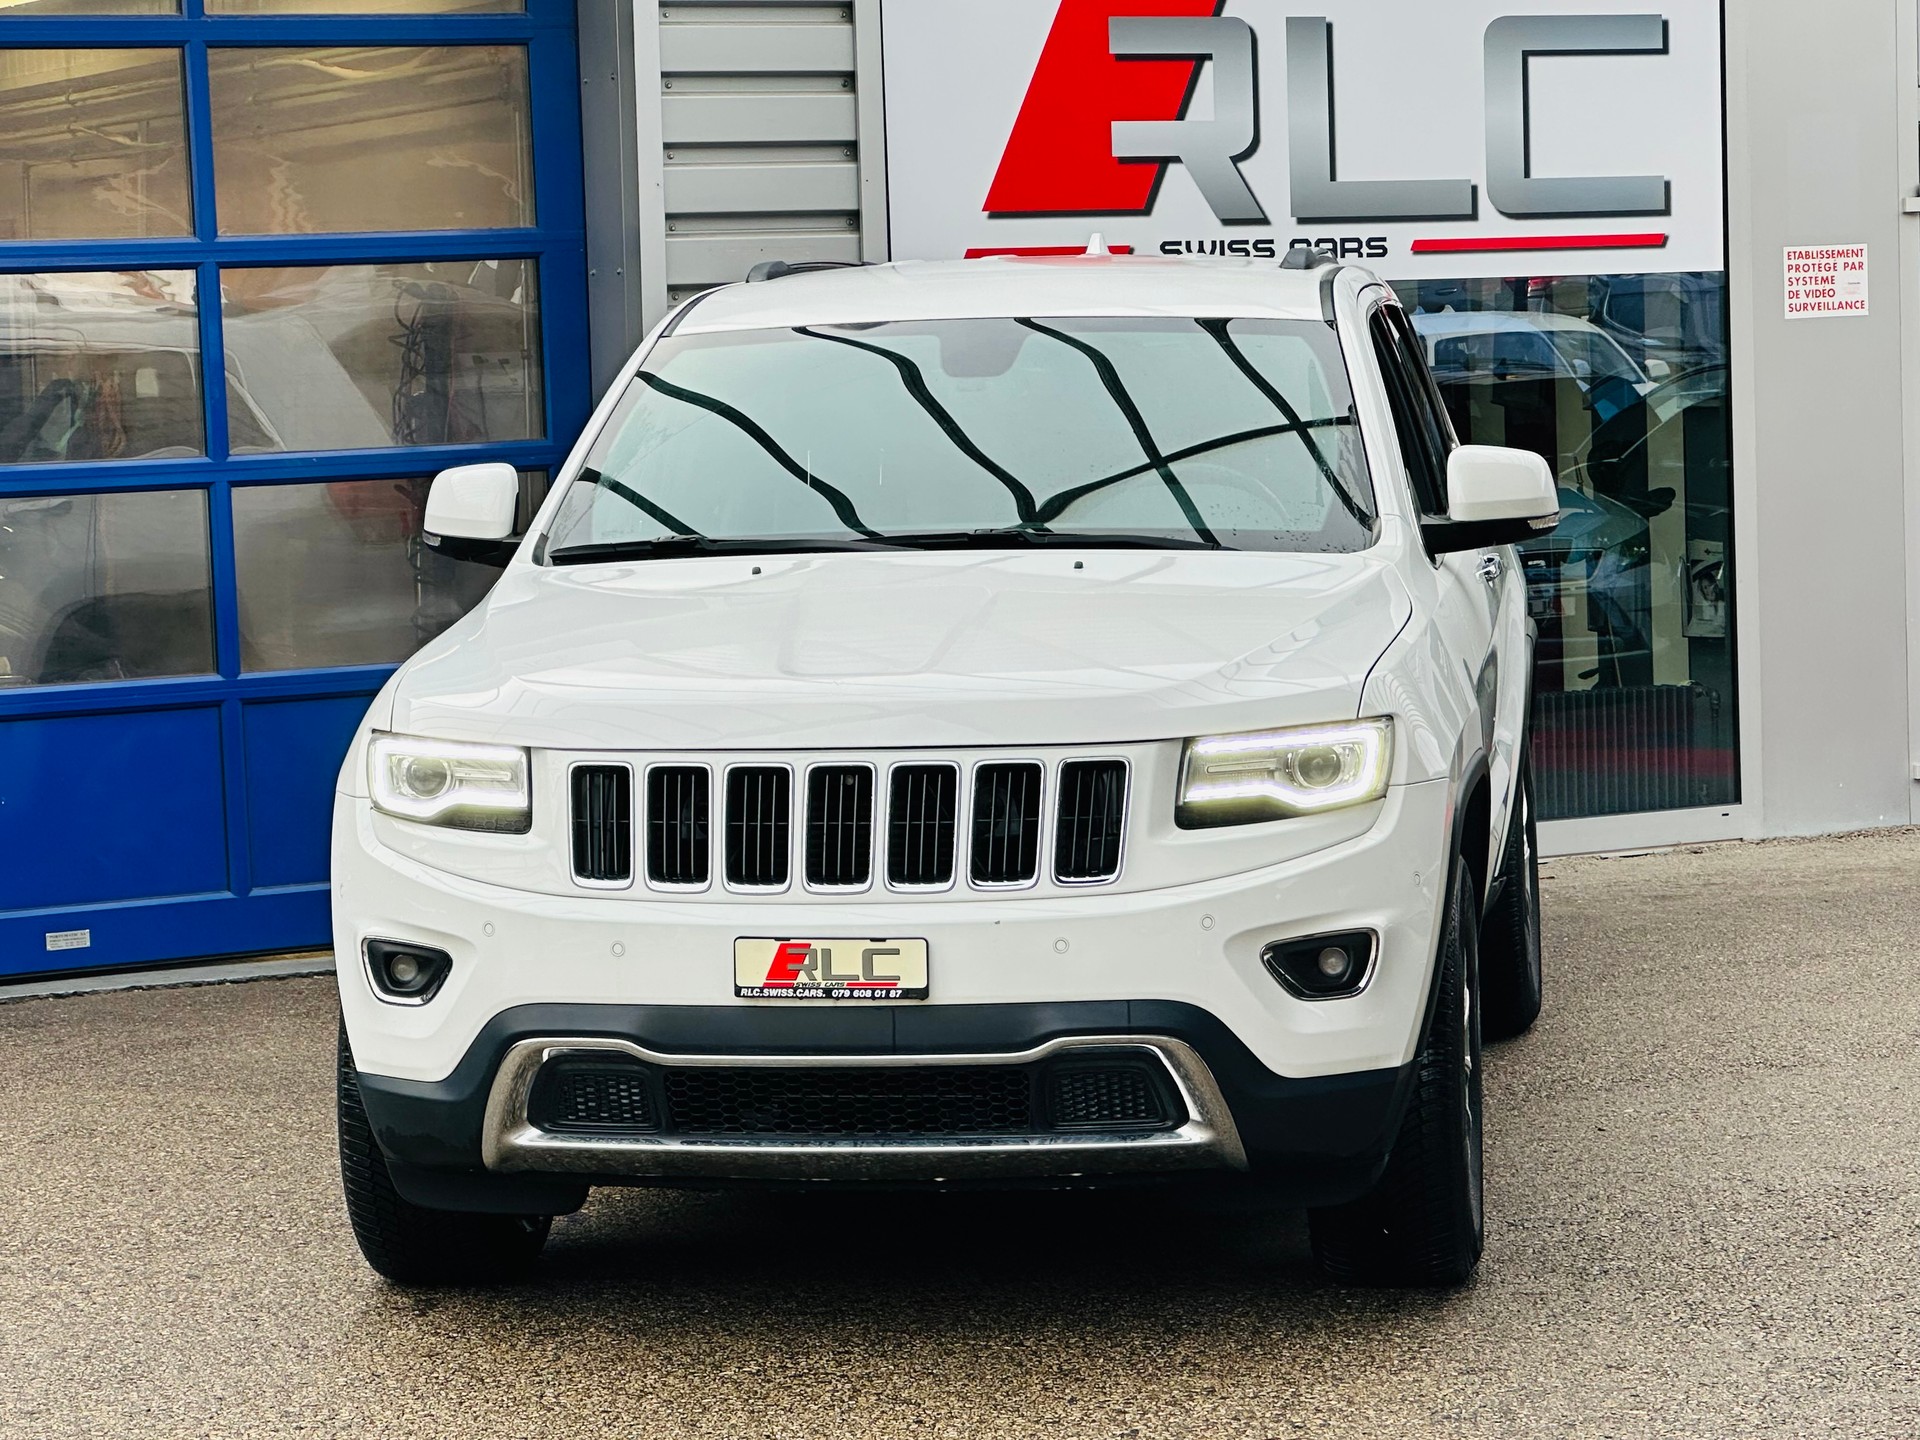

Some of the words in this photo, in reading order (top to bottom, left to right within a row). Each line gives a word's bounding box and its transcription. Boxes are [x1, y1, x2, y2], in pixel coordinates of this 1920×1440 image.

[1109, 14, 1669, 224] RLC
[1160, 239, 1275, 258] SWISS
[1787, 248, 1864, 260] ETABLISSEMENT
[1843, 262, 1864, 271] PAR
[1788, 290, 1800, 299] DE
[1804, 286, 1836, 299] VIDÉO
[1788, 300, 1865, 312] SURVEILLANCE
[787, 948, 900, 981] RLC
[740, 988, 826, 998] RLC.SWISS.CARS.
[831, 989, 850, 998] 079
[853, 989, 872, 998] 608
[874, 989, 887, 998] 01
[889, 989, 902, 998] 87
